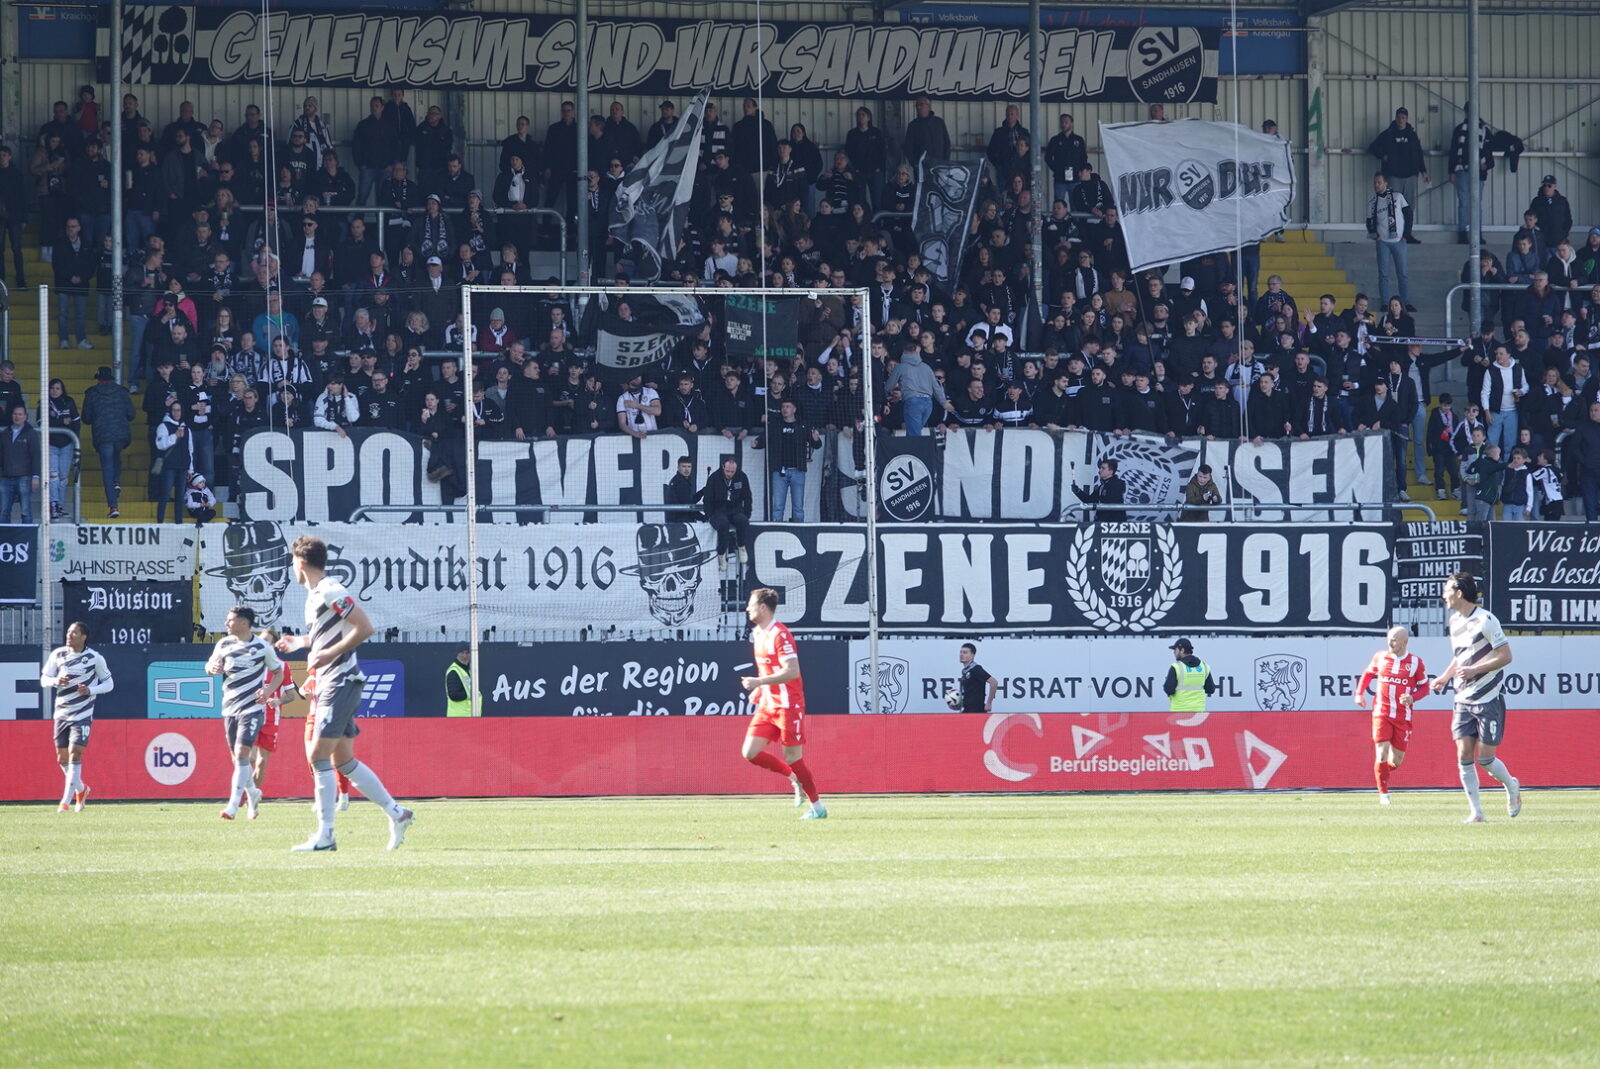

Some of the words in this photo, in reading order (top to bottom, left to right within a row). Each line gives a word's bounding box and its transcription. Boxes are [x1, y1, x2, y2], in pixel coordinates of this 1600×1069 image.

[938, 13, 979, 22] Volksbank
[1252, 17, 1292, 27] Volksbank
[209, 11, 530, 88] GEMEINSAM
[669, 20, 778, 90] WIR
[778, 24, 1116, 100] SANDHAUSEN
[1137, 26, 1181, 67] SV
[1142, 55, 1197, 89] SANDHAUSEN
[1163, 81, 1186, 100] 1916
[1179, 163, 1201, 188] SV
[886, 460, 917, 491] SV
[890, 482, 928, 508] SANDHAUSEN
[905, 500, 921, 513] 1916
[77, 526, 160, 545] SEKTION
[1100, 522, 1151, 534] SZENE
[1407, 520, 1468, 537] NIEMALS
[1411, 539, 1467, 557] ALLEINE
[1526, 529, 1575, 553] Was
[63, 559, 175, 575] JAHNSTRASSE
[523, 545, 617, 592] 1916
[753, 531, 1052, 623] SZENE
[1196, 531, 1391, 623] 1916
[1419, 561, 1461, 577] IMMER
[1508, 556, 1548, 584] das
[1110, 595, 1143, 608] 1916
[1510, 594, 1553, 622] FÜR
[111, 627, 151, 645] 1916!
[492, 673, 547, 703] Aus
[560, 664, 610, 697] der
[622, 656, 719, 696] Region
[1090, 676, 1155, 699] VON
[1557, 673, 1600, 695] BU
[80, 724, 91, 737] 10
[249, 717, 259, 731] 5
[1489, 720, 1498, 734] 6
[153, 746, 189, 768] iba
